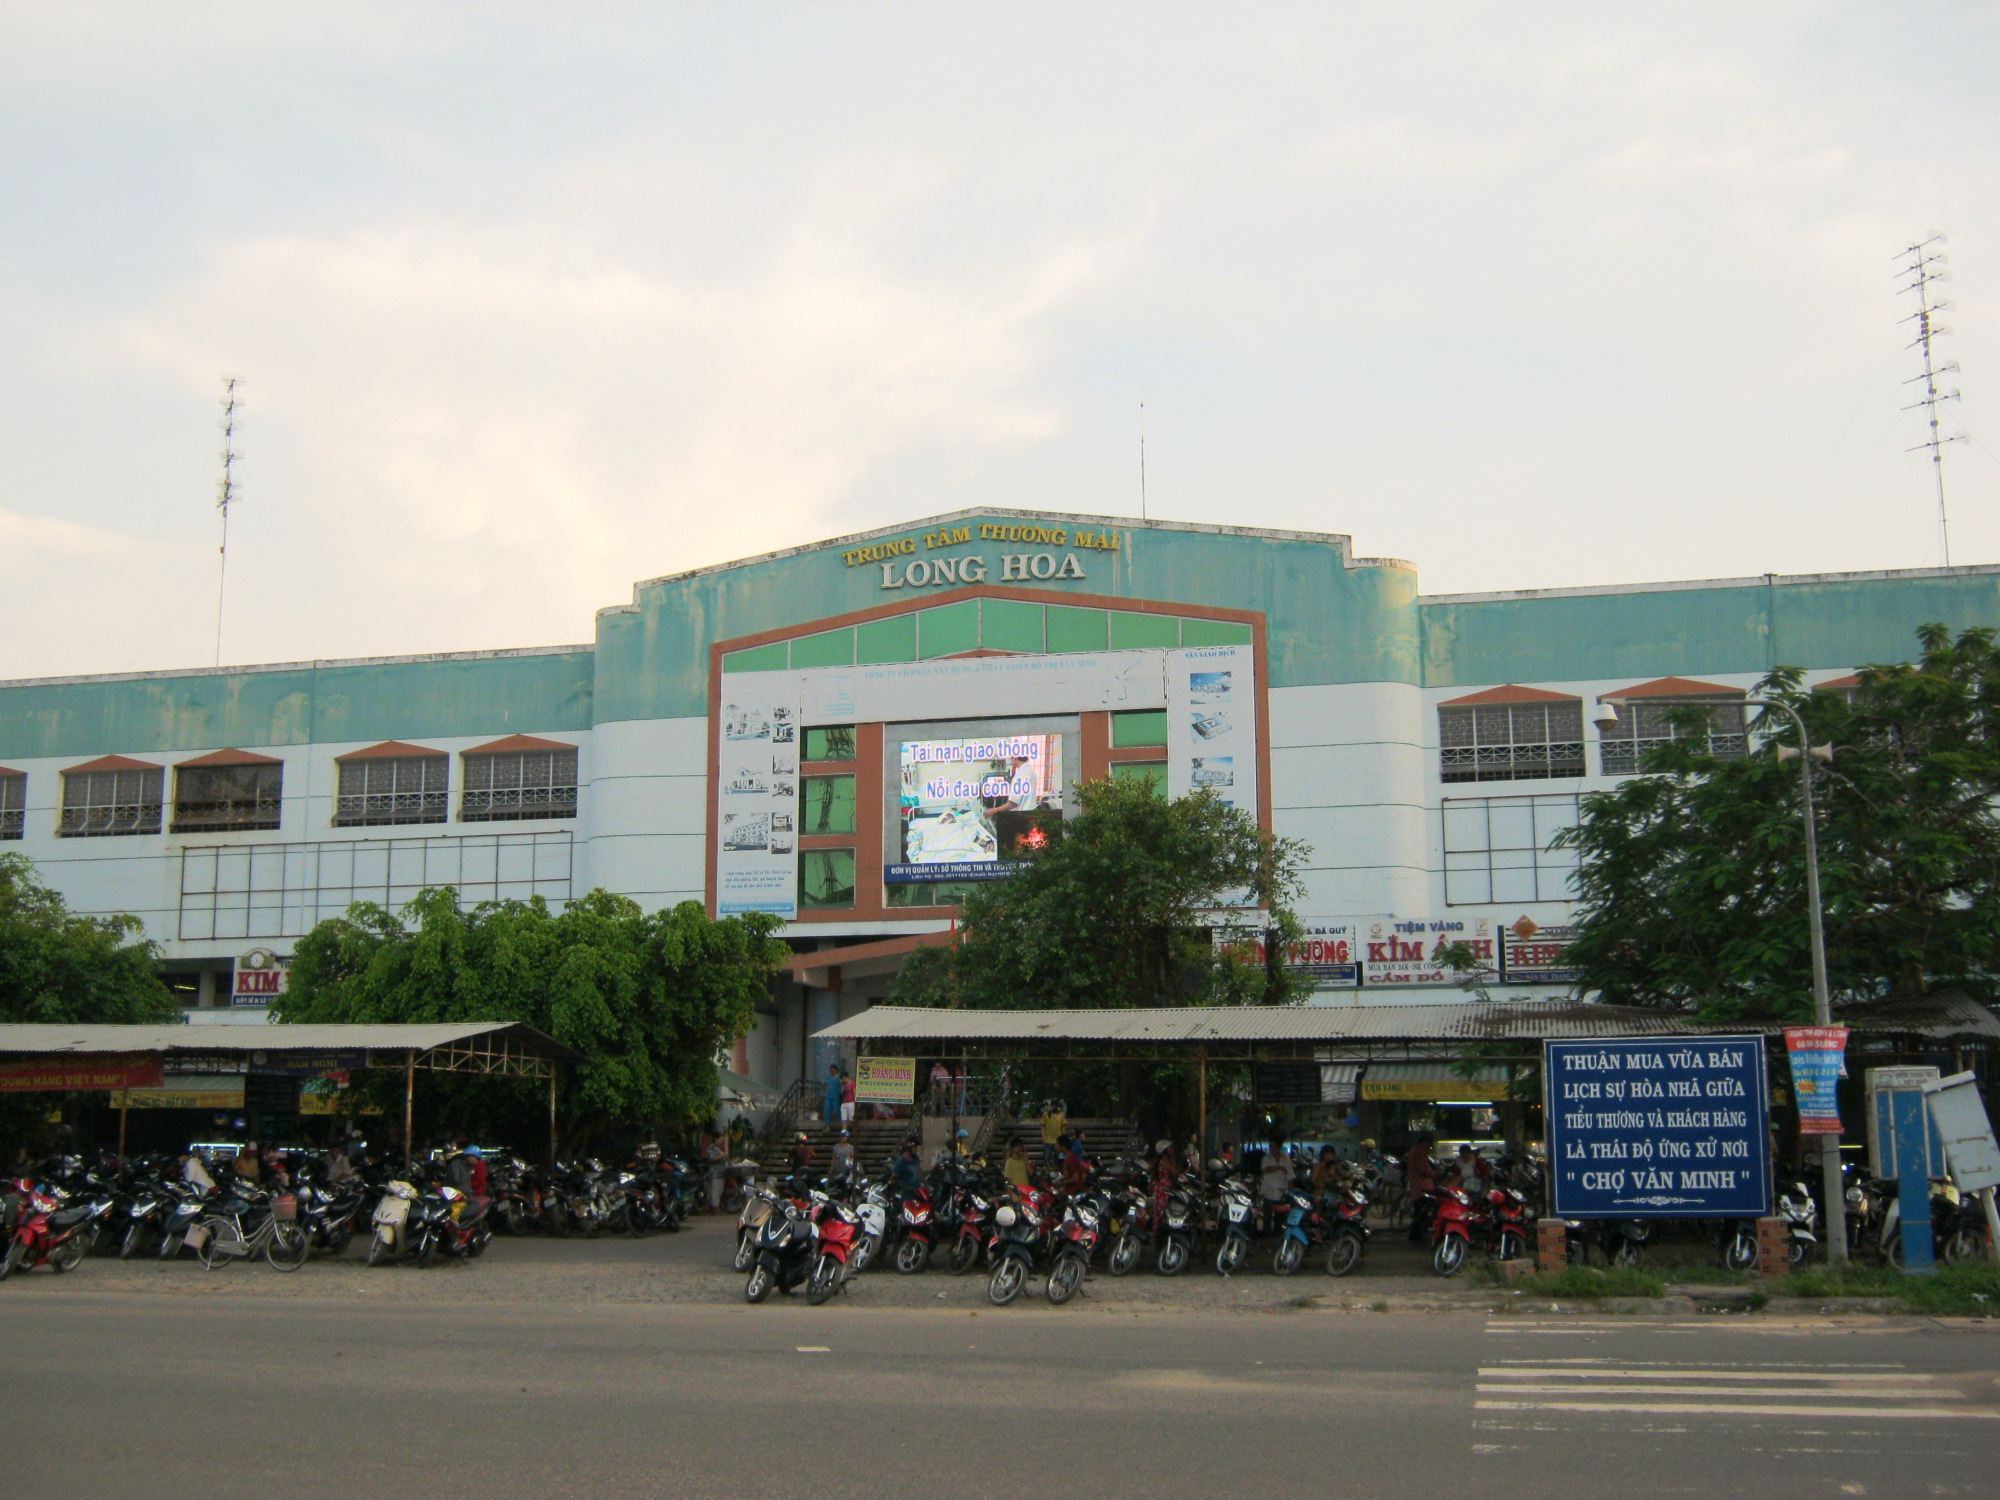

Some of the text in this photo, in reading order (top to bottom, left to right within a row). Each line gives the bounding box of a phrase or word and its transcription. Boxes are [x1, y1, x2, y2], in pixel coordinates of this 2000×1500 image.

[842, 523, 1121, 567] TRUNG TÂM THƯƠNG MẠI
[880, 552, 1087, 589] LONG HOA
[910, 739, 1038, 764] Tai nạn giao thông
[926, 777, 949, 799] Nỗi
[954, 781, 980, 798] đau
[1013, 778, 1031, 796] đó
[891, 866, 904, 875] ĐƠN
[912, 864, 930, 873] QUẢN
[941, 863, 949, 872] SỞ
[951, 862, 972, 872] THÔNG
[984, 862, 992, 871] VÀ
[1394, 920, 1464, 934] TIỆM VÀNG
[1367, 935, 1424, 962] KIM
[237, 972, 281, 993] KIM
[1563, 1048, 1744, 1073] THUẬN MUA VỪA BÁN
[33, 1074, 63, 1087] HÀNG
[65, 1073, 90, 1088] VIỆT
[1564, 1077, 1746, 1102] LỊCH SỰ HÒA NHÃ GIỮA
[1565, 1104, 1747, 1128] TIỂU THƯƠNG VÀ KHÁCH HÀNG
[1566, 1136, 1749, 1161] LÀ THÁI ĐỘ ỨNG XỬ NƠI
[1582, 1169, 1625, 1193] CHỢ
[1631, 1167, 1673, 1189] VĂN
[1681, 1171, 1736, 1189] MINH
